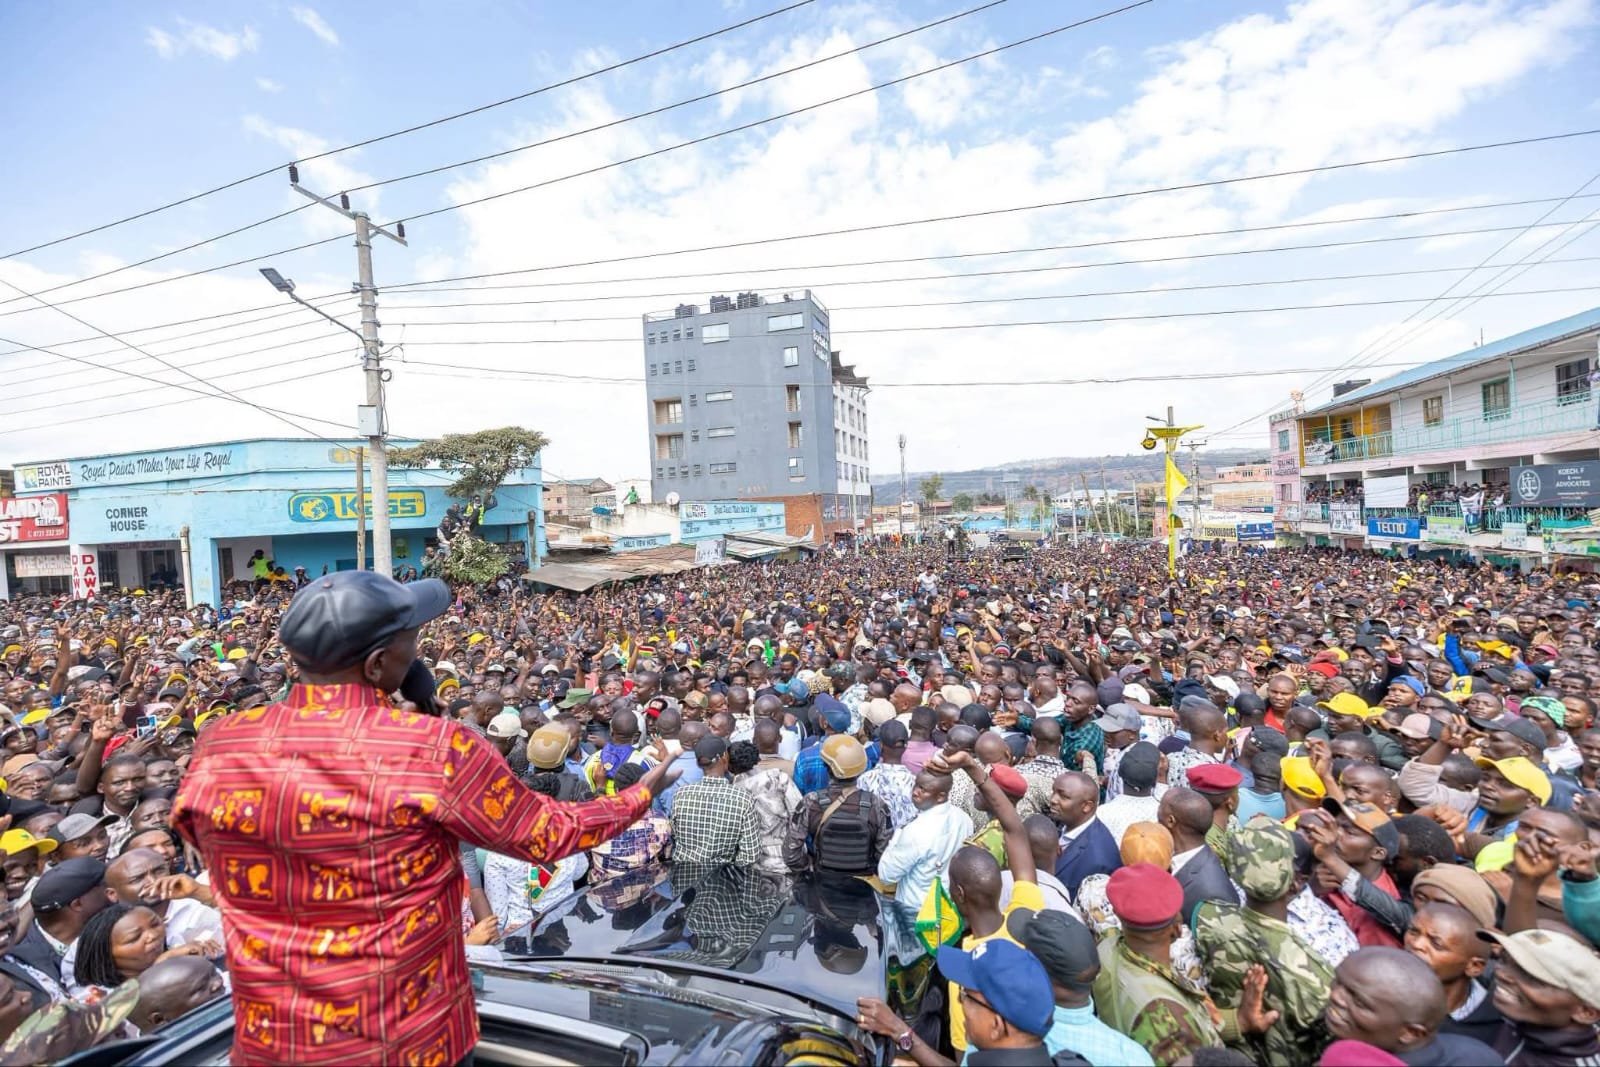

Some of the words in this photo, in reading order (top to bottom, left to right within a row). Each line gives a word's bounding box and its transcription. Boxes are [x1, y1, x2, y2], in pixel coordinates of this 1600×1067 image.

[38, 464, 70, 477] ROYAL
[81, 461, 106, 481] Royal
[109, 460, 136, 480] Paints
[137, 457, 164, 474] Makes
[165, 456, 185, 475] Your
[186, 453, 201, 472] Life
[204, 450, 233, 471] Royal
[38, 476, 71, 488] PAINTS
[105, 506, 148, 519] CORNER
[110, 520, 146, 532] HOUSE
[1376, 521, 1407, 535] TECNO
[18, 556, 35, 569] THE
[36, 555, 71, 569] CHEMIS
[72, 555, 81, 600] DAWA
[82, 554, 96, 601] DAWA
